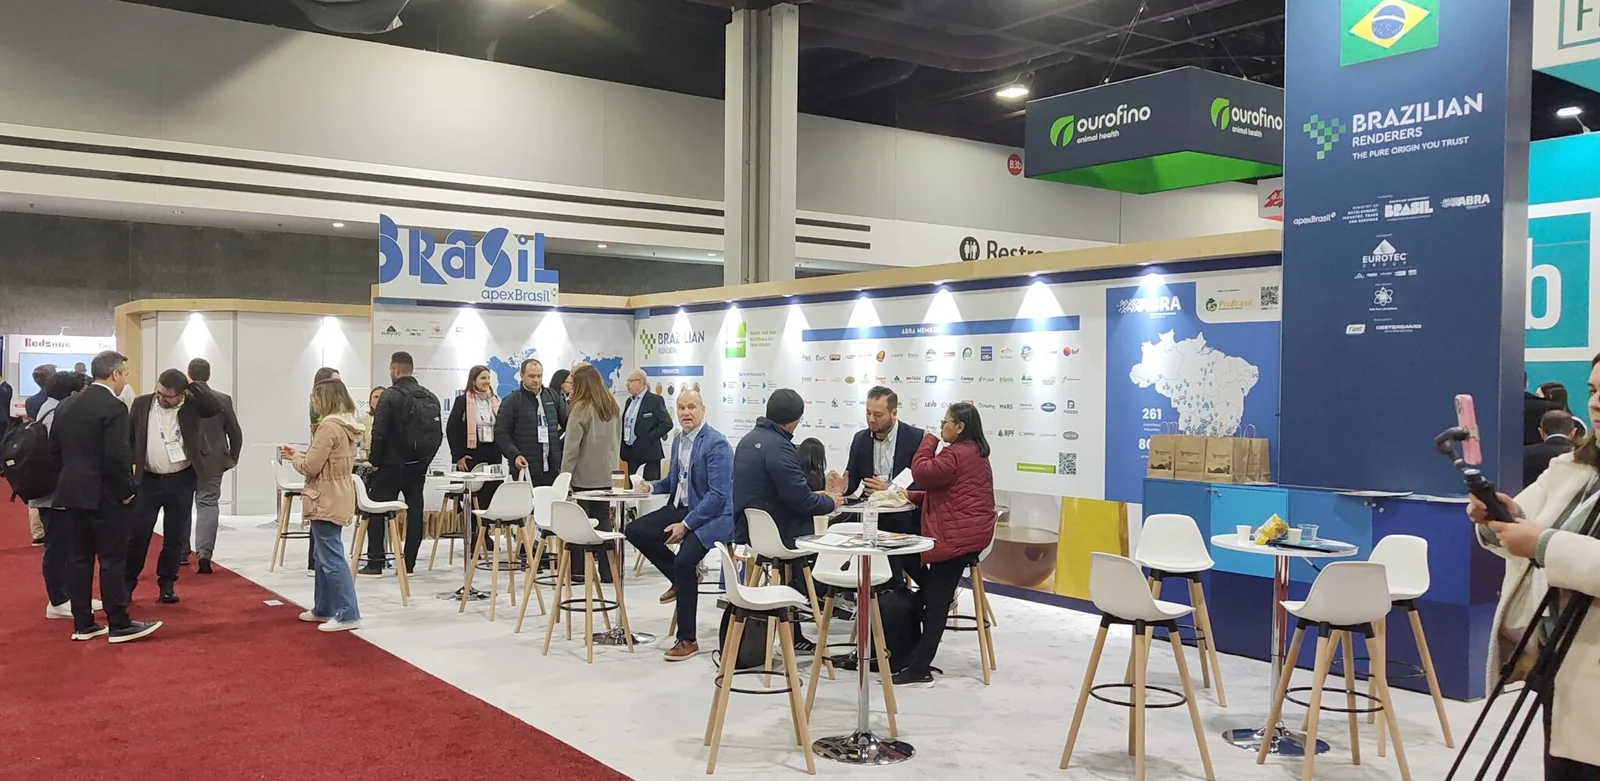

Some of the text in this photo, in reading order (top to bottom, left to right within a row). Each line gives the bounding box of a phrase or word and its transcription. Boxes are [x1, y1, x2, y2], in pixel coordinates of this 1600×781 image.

[1077, 104, 1151, 133] ourofino
[1231, 102, 1283, 130] ourofino
[1352, 92, 1483, 133] BRAZILIAN
[1077, 130, 1120, 144] animal health
[1231, 126, 1262, 137] animal health
[1352, 127, 1423, 147] RENDERERS
[1352, 136, 1470, 160] THE PURE ORIGIN YOU TRUST
[1009, 160, 1022, 170] B3b
[1458, 194, 1490, 207] ABRA
[1384, 200, 1434, 218] BRASIL
[1293, 213, 1331, 226] apexBrasil
[1362, 252, 1408, 264] EUROTEC
[481, 288, 550, 303] apexBrasil
[1142, 408, 1162, 420] 261
